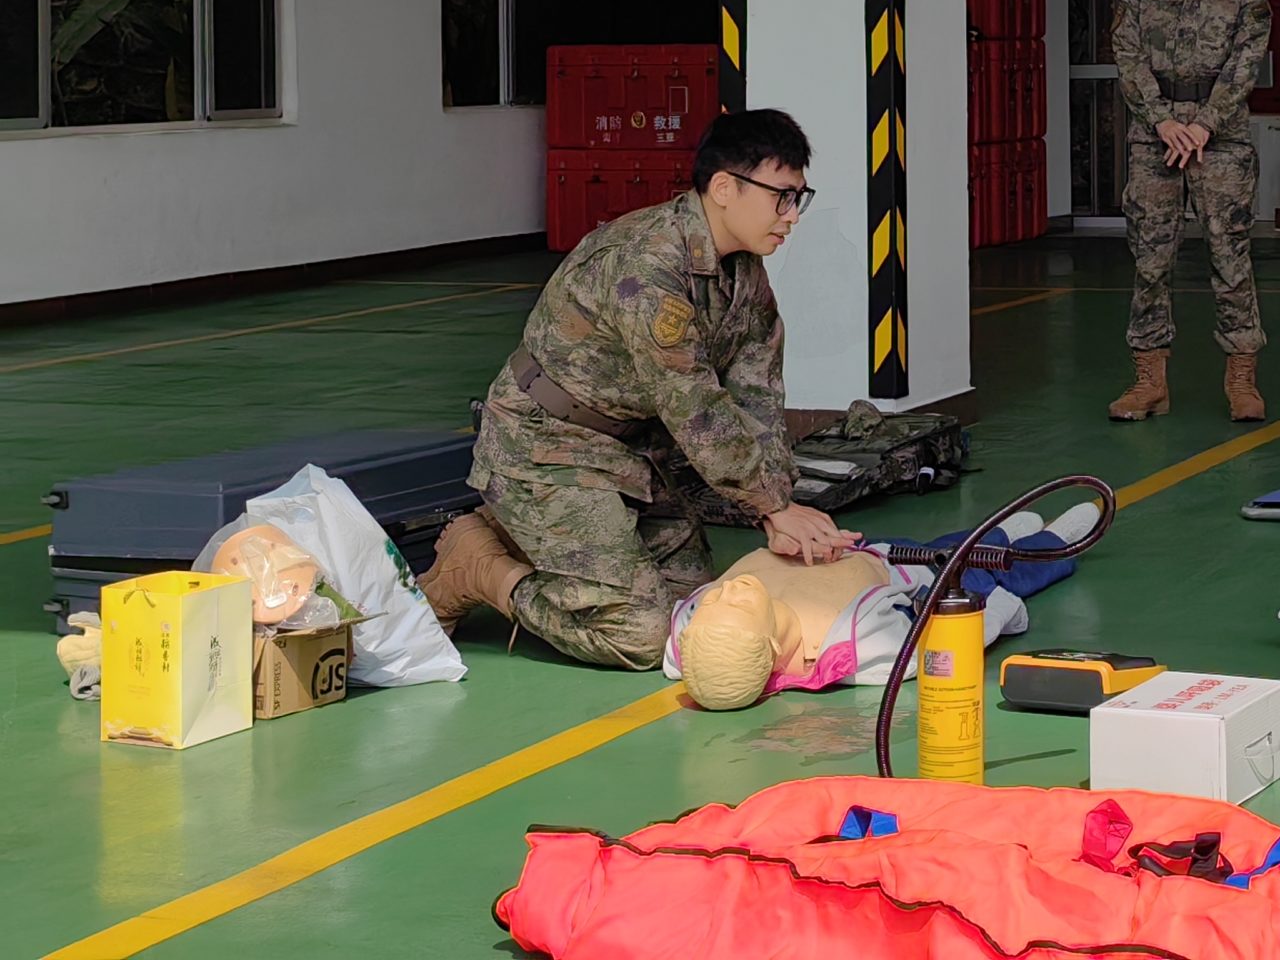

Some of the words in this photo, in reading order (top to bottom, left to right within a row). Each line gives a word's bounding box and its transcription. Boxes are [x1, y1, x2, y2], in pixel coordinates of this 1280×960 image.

[595, 115, 622, 131] 消防
[654, 115, 682, 130] 救援
[273, 661, 282, 697] EXPRESS
